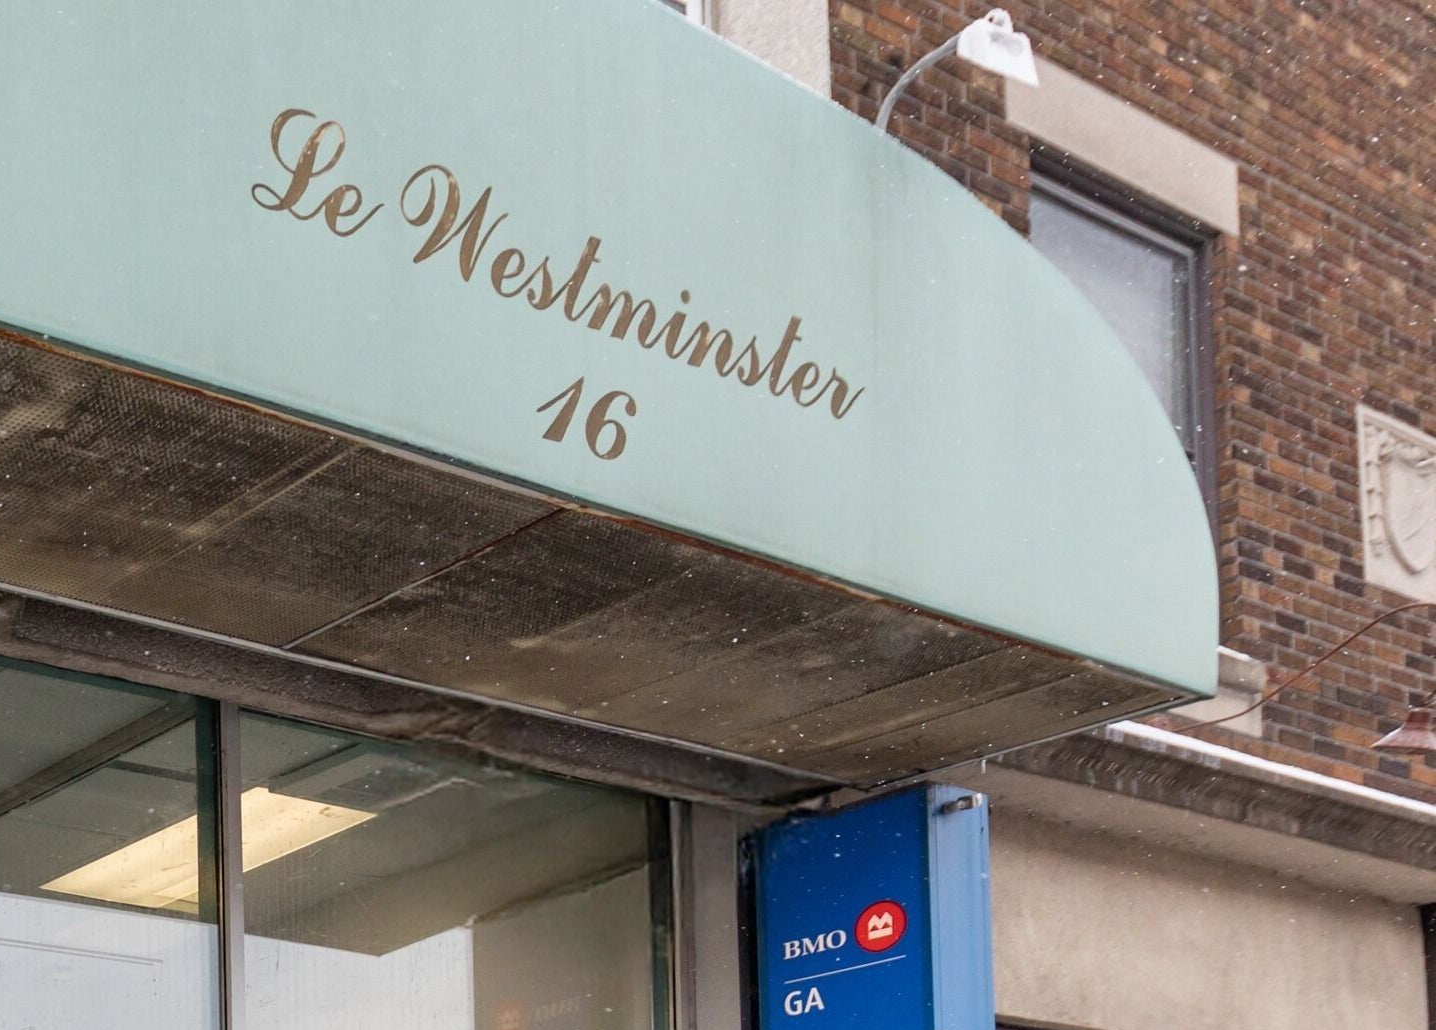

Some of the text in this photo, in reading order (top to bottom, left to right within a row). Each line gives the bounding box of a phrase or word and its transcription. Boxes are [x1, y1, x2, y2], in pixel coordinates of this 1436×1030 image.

[251, 108, 865, 419] Le Westminster
[537, 376, 637, 460] 16
[783, 929, 847, 960] BMO
[784, 987, 825, 1016] GA
